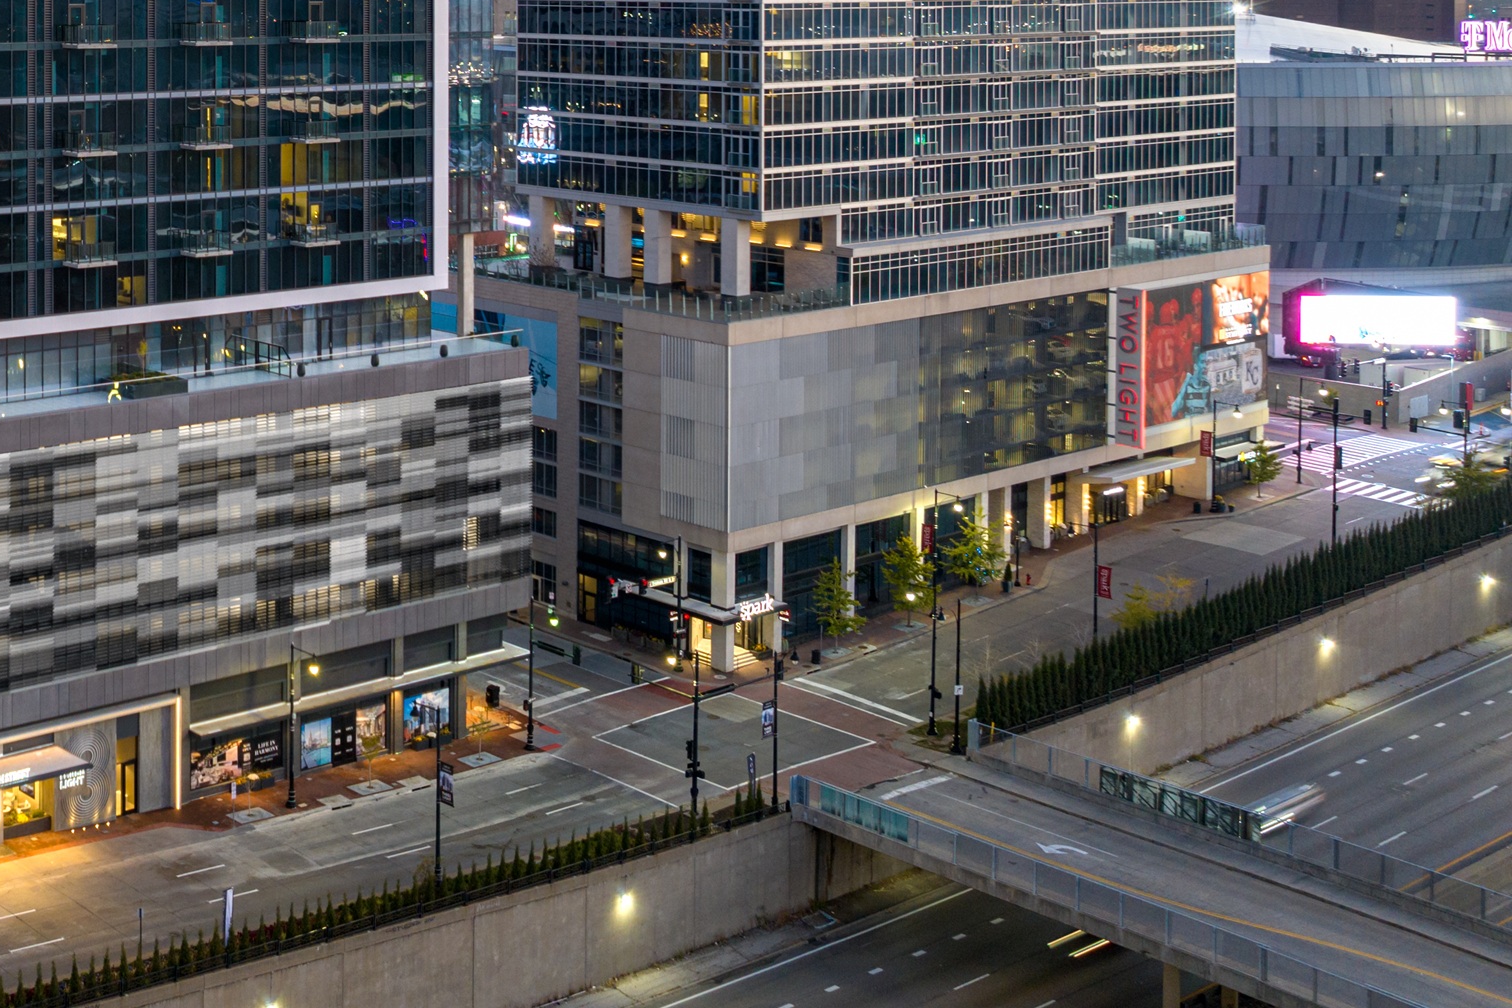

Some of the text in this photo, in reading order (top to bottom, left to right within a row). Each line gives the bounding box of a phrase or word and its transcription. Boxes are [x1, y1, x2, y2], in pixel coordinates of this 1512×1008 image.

[1117, 295, 1139, 443] TWO LIGHT
[1245, 360, 1259, 386] KC
[740, 593, 774, 621] spark
[254, 745, 278, 756] HARMONY
[257, 741, 269, 749] LIFE
[59, 775, 85, 790] LIGHT
